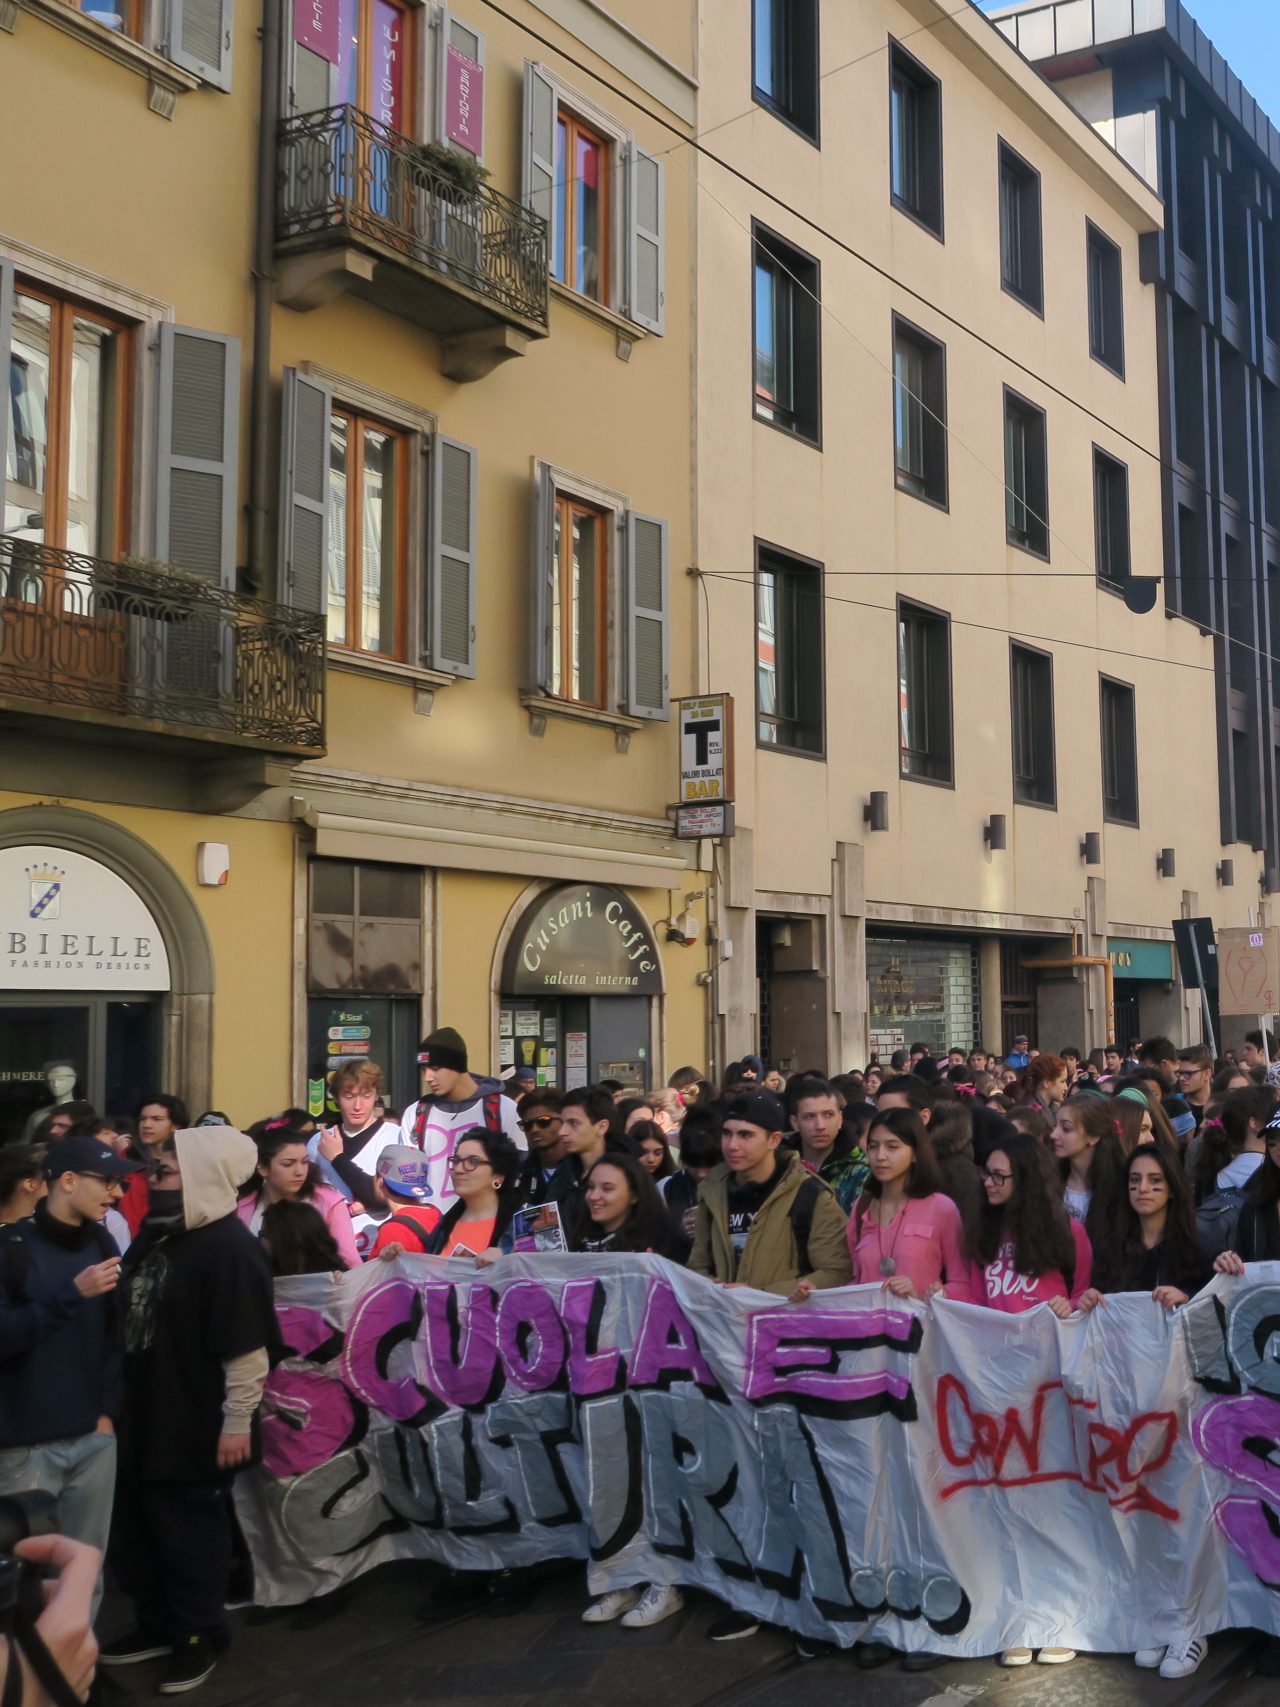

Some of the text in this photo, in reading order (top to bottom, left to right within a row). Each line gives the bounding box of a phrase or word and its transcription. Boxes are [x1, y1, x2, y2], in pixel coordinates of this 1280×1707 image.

[458, 67, 471, 136] SARTORIA
[684, 719, 721, 766] T
[681, 767, 700, 780] VALORI
[686, 779, 720, 800] BAR
[523, 891, 594, 973] Cusani
[0, 931, 152, 958] BIELLE
[11, 959, 152, 970] FASHION DESIGN
[544, 970, 639, 986] saletta interna
[346, 1013, 363, 1021] Sisal
[0, 1071, 45, 1081] HMERE
[262, 1275, 923, 1478] SCUOLA E
